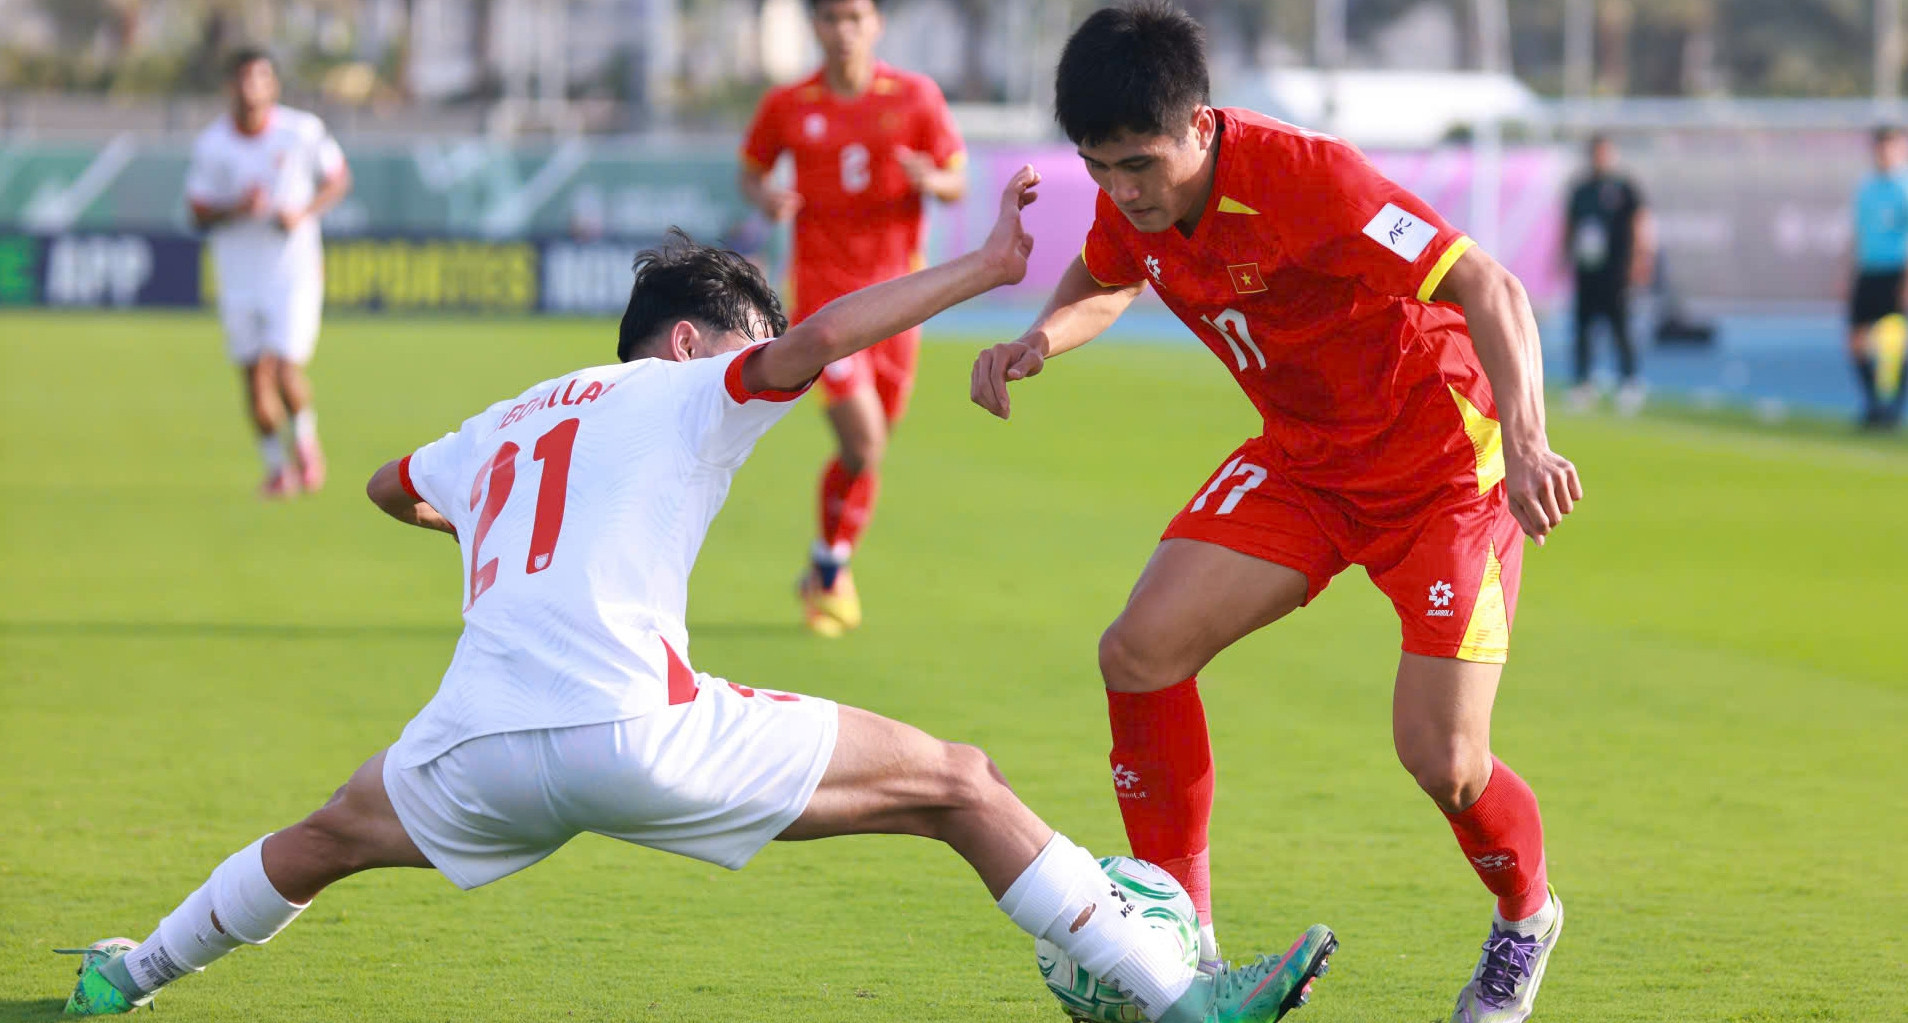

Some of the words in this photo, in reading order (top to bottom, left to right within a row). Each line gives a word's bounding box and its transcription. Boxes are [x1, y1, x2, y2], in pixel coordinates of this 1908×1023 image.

[1389, 216, 1412, 245] AFC
[48, 235, 153, 304] APP
[1200, 308, 1267, 371] 17
[463, 418, 580, 614] 21
[1190, 455, 1268, 515] 17
